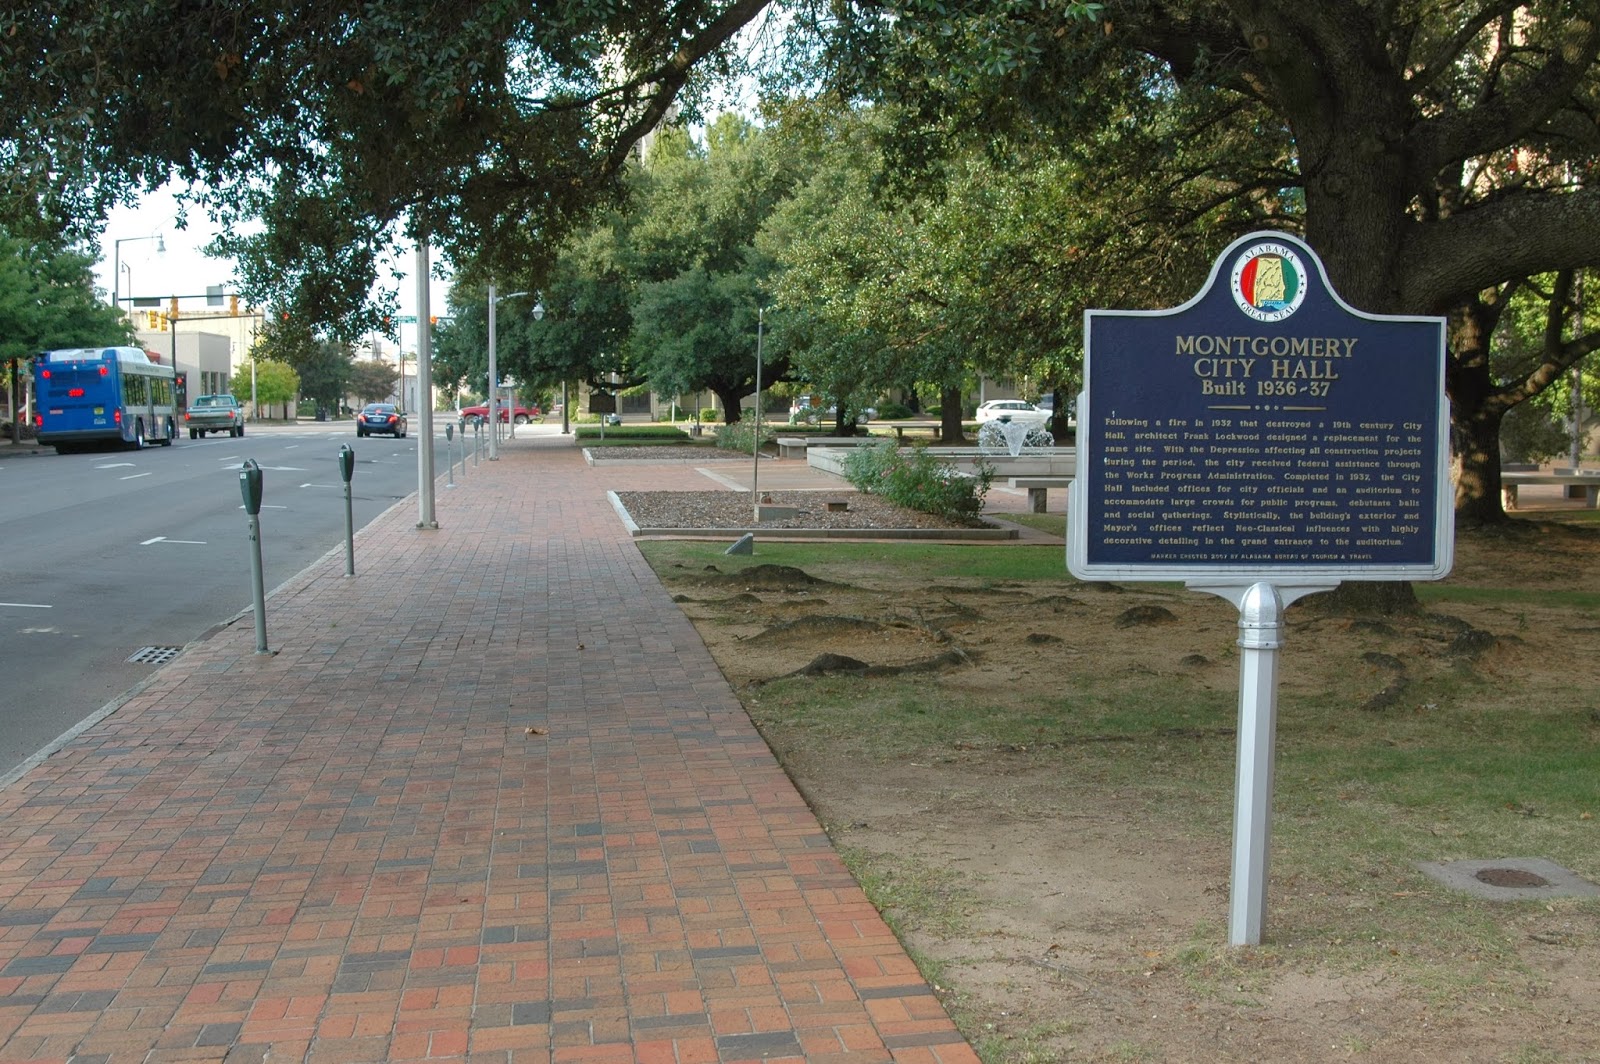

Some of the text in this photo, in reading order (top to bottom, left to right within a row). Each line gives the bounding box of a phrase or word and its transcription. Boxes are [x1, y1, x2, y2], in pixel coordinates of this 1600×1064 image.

[1245, 245, 1294, 261] ALABAMA
[1241, 302, 1297, 320] GREAT SEAL
[1175, 335, 1359, 358] MONTGOMERY
[1194, 358, 1339, 379] CITY HALL
[1202, 380, 1246, 395] Built
[1105, 418, 1148, 427] Following
[1266, 421, 1311, 431] destroyed
[1403, 423, 1422, 431] City
[1266, 434, 1307, 442] designed
[1265, 447, 1305, 455] affecting
[1384, 448, 1421, 456] projects
[1105, 458, 1134, 467] during
[1226, 459, 1245, 467] city
[1387, 461, 1421, 469] through
[1161, 472, 1201, 480] Progress
[1284, 473, 1329, 481] Completed
[1402, 474, 1420, 482] City
[1171, 499, 1195, 507] large
[1261, 499, 1288, 507] public
[1104, 524, 1137, 532] Mayor's
[1159, 538, 1199, 546] detailing
